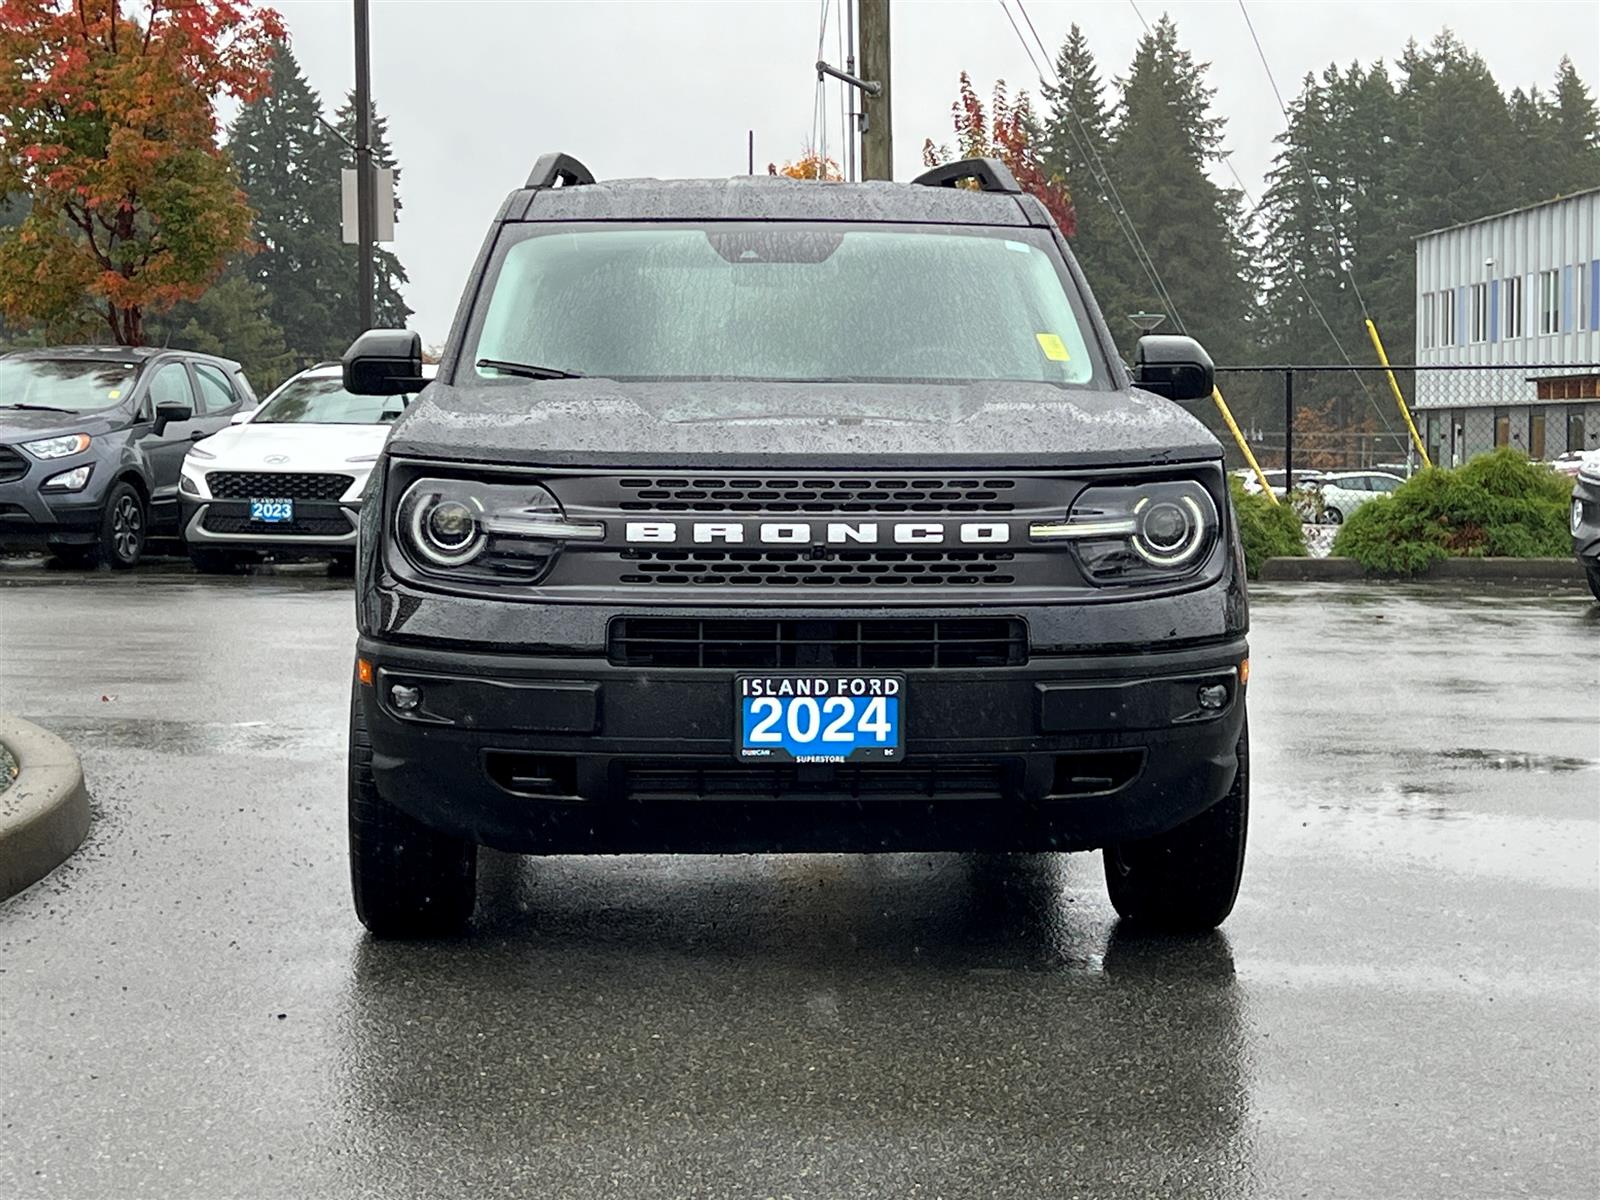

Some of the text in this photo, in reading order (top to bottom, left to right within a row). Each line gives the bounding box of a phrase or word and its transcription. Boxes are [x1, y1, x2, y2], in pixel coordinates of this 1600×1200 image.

[253, 503, 292, 518] 2023
[626, 522, 1010, 543] BRONCO
[742, 678, 899, 696] ISLAND FORD
[749, 696, 892, 743] 2024
[796, 755, 845, 763] SUPERSTORE
